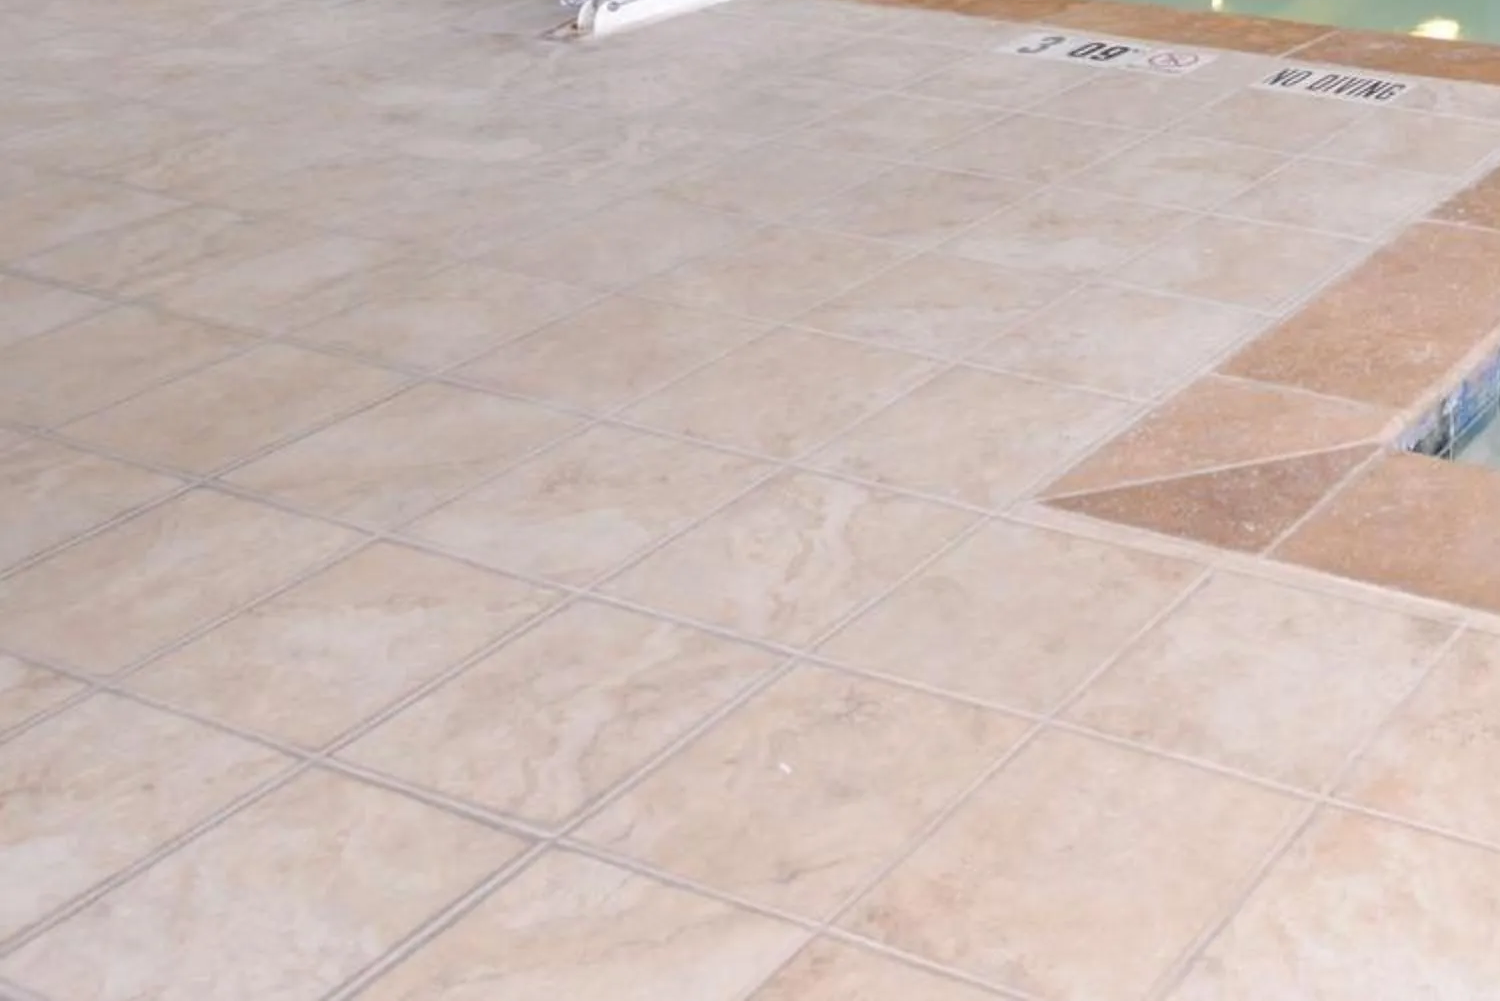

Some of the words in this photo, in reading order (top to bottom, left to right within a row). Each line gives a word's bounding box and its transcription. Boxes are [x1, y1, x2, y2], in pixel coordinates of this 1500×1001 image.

[1017, 35, 1066, 54] 3
[1263, 68, 1313, 88] NO
[1305, 74, 1406, 100] DIVING
